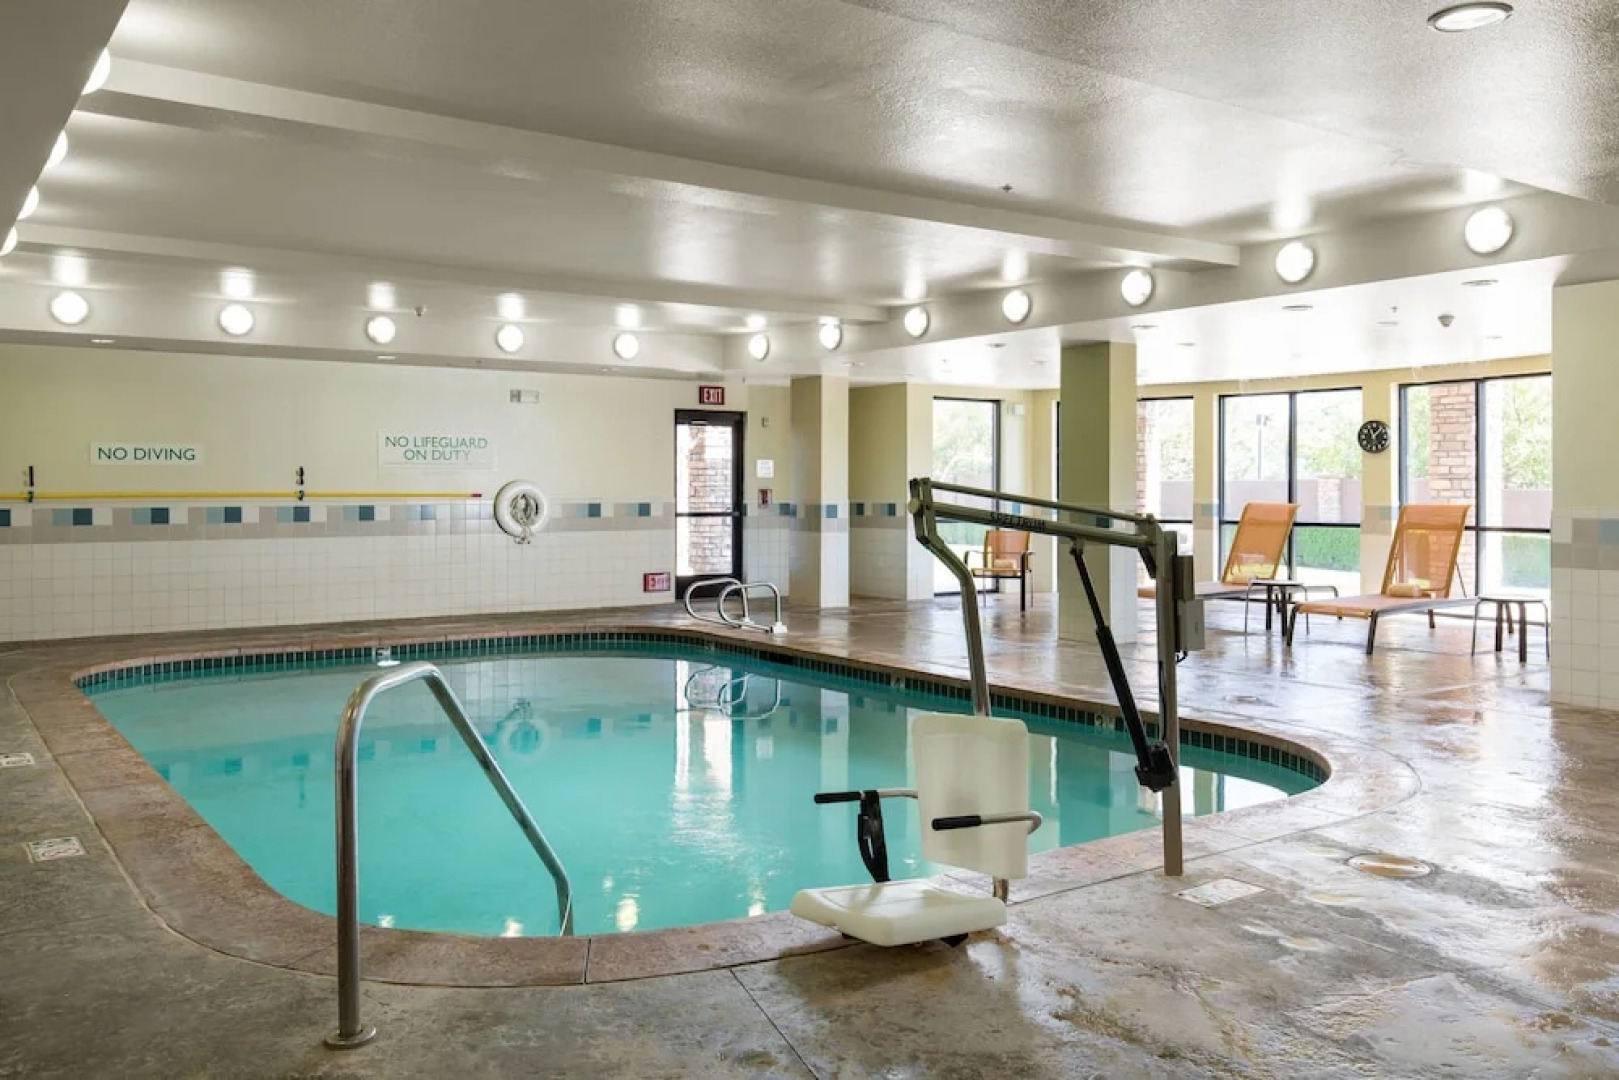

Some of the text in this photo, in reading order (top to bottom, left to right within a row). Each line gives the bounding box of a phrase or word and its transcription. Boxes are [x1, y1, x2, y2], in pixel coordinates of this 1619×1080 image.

[703, 388, 723, 403] EXIT
[384, 436, 488, 449] NO LIFEGUARD
[98, 447, 195, 461] NO DIVING
[403, 449, 471, 460] ON DUTY
